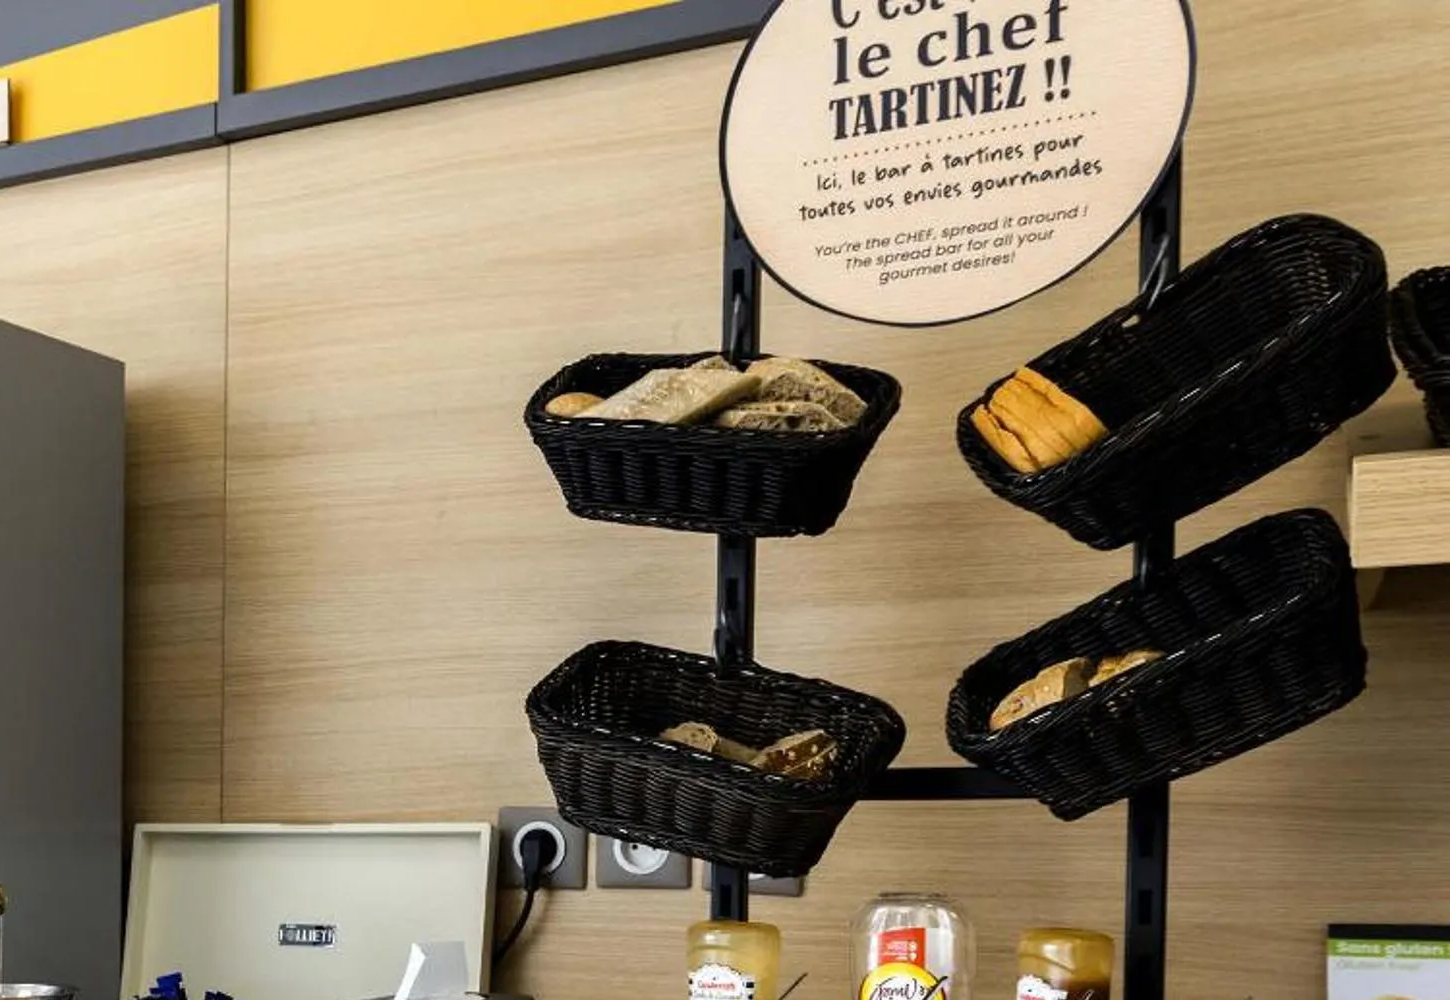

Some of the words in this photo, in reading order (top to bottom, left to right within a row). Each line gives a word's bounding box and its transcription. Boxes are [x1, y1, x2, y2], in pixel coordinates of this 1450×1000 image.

[832, 36, 891, 85] le
[917, 0, 1069, 67] chef
[829, 64, 1027, 140] TARTINEZ
[1044, 55, 1071, 102] !!
[798, 200, 856, 221] toutes
[863, 193, 895, 211] vos
[903, 182, 963, 205] envies
[971, 158, 1103, 199] gourmandes
[816, 173, 843, 191] Ici,
[851, 169, 867, 186] le
[875, 164, 912, 182] bar
[920, 153, 934, 173] à
[942, 144, 1024, 170] tartines
[1034, 134, 1084, 161] pour
[814, 240, 862, 257] You're
[865, 237, 891, 250] the
[941, 216, 999, 240] spread
[1002, 215, 1013, 229] it
[1016, 205, 1080, 227] around
[844, 256, 873, 272] The
[875, 246, 932, 268] spread
[935, 242, 962, 257] bar
[967, 238, 990, 251] for
[992, 233, 1015, 247] all
[1016, 229, 1055, 249] your
[878, 261, 948, 286] gourmet
[951, 251, 1016, 272] desires!
